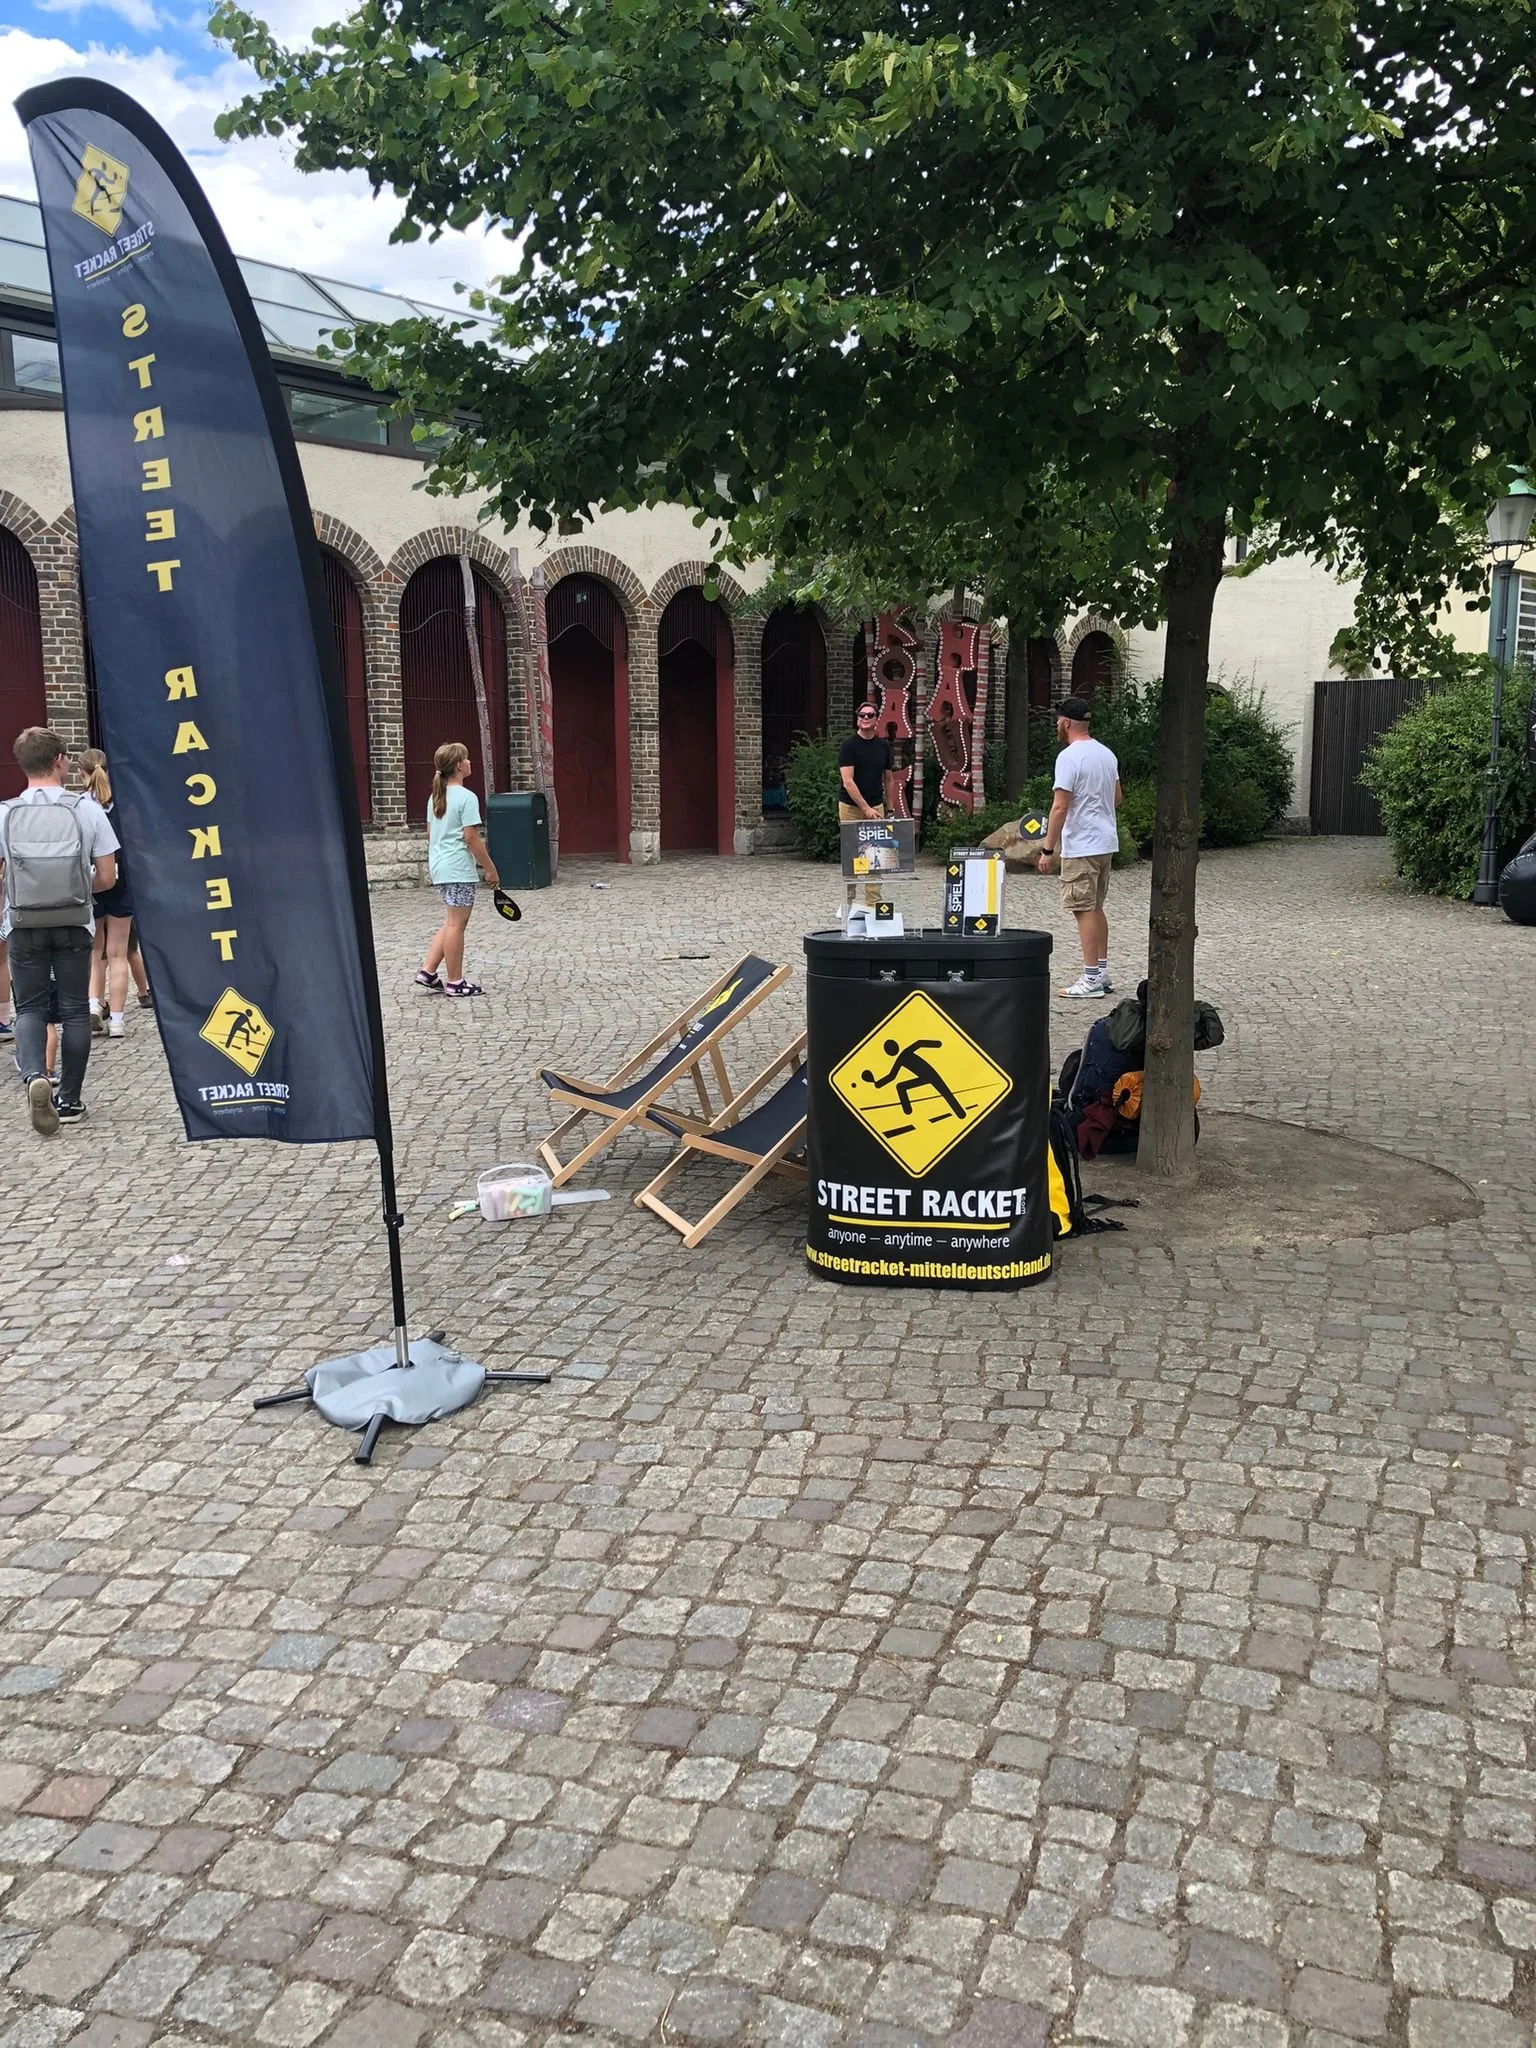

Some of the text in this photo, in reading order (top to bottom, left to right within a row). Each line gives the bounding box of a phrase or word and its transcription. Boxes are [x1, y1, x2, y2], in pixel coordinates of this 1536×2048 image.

[858, 829, 893, 842] SPIEL
[952, 879, 963, 912] SPIEL
[817, 1179, 1026, 1218] STREET RACKET
[827, 1226, 866, 1245] anyone
[884, 1231, 932, 1249] anytime
[951, 1233, 1010, 1252] anywhere
